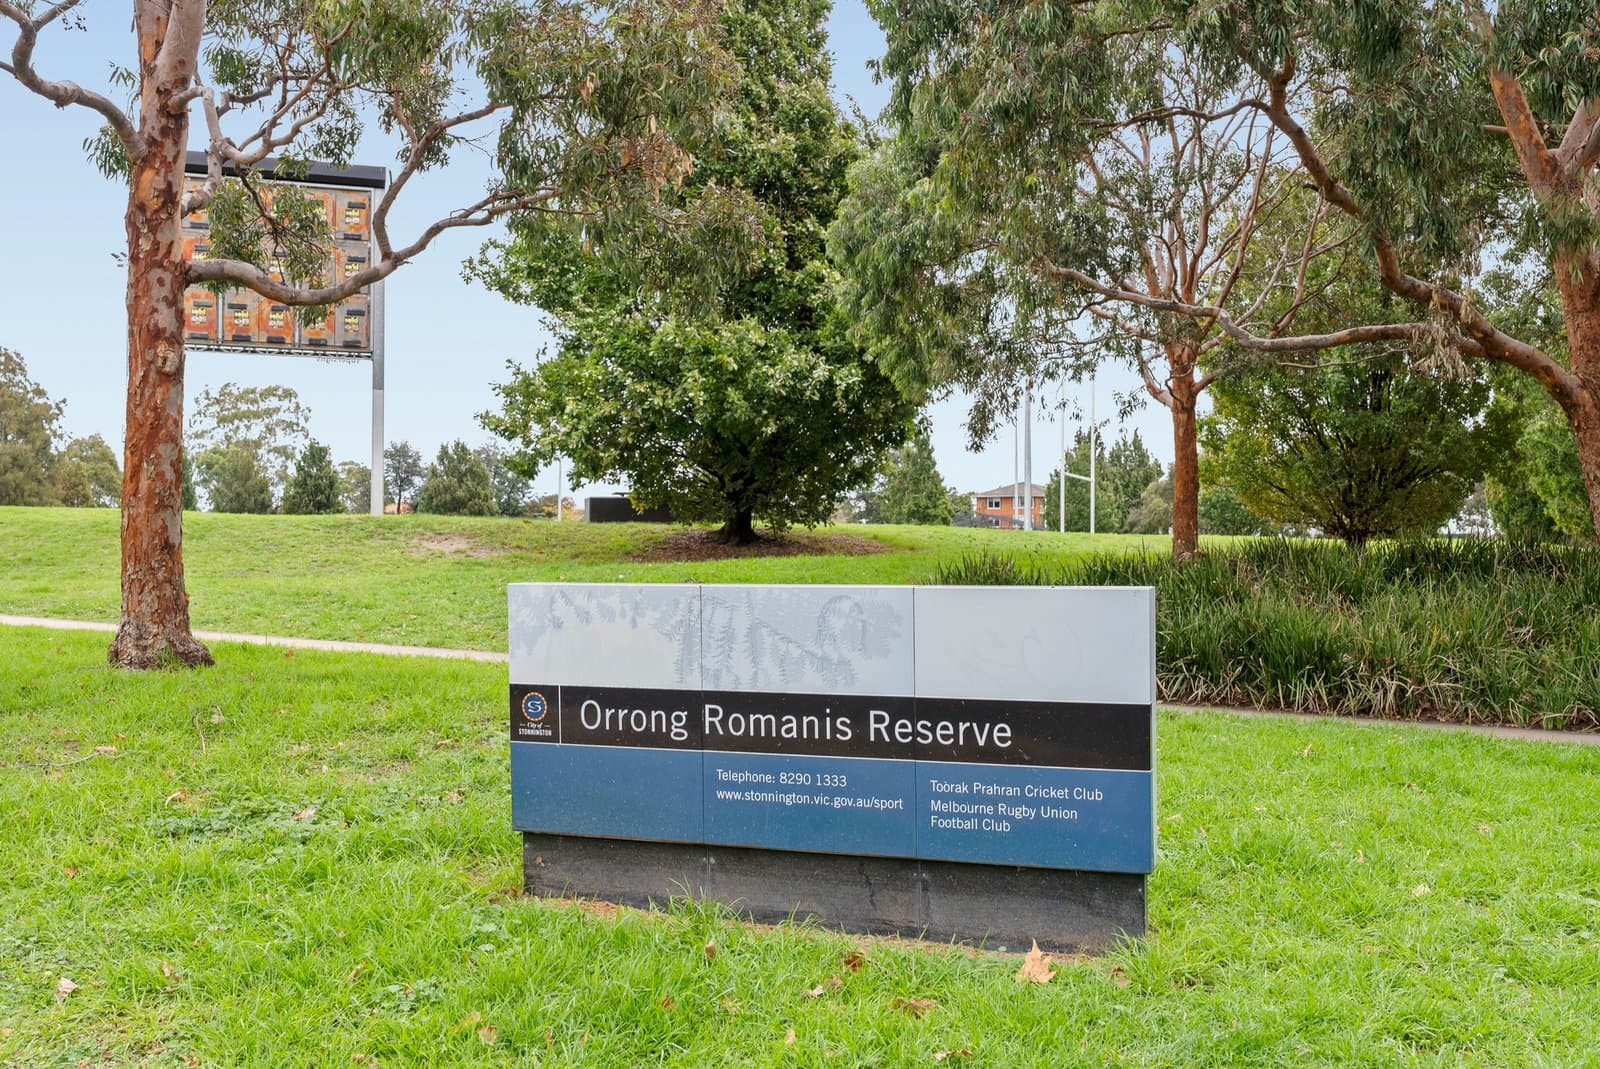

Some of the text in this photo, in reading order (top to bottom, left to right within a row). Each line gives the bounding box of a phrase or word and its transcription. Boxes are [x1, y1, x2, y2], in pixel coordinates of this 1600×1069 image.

[527, 700, 542, 713] S
[518, 728, 552, 737] STONNINGTON
[580, 699, 1013, 748] Orrong Romanis Reserve
[716, 769, 848, 788] Telephone: 8290 1333
[715, 789, 904, 812] www.stonnington.vic.gov.au/sport
[929, 780, 1104, 802] Toorak Prahran Cricket Club
[930, 799, 1079, 821] Melbourne Rugby Union
[929, 815, 1011, 833] Football Club
